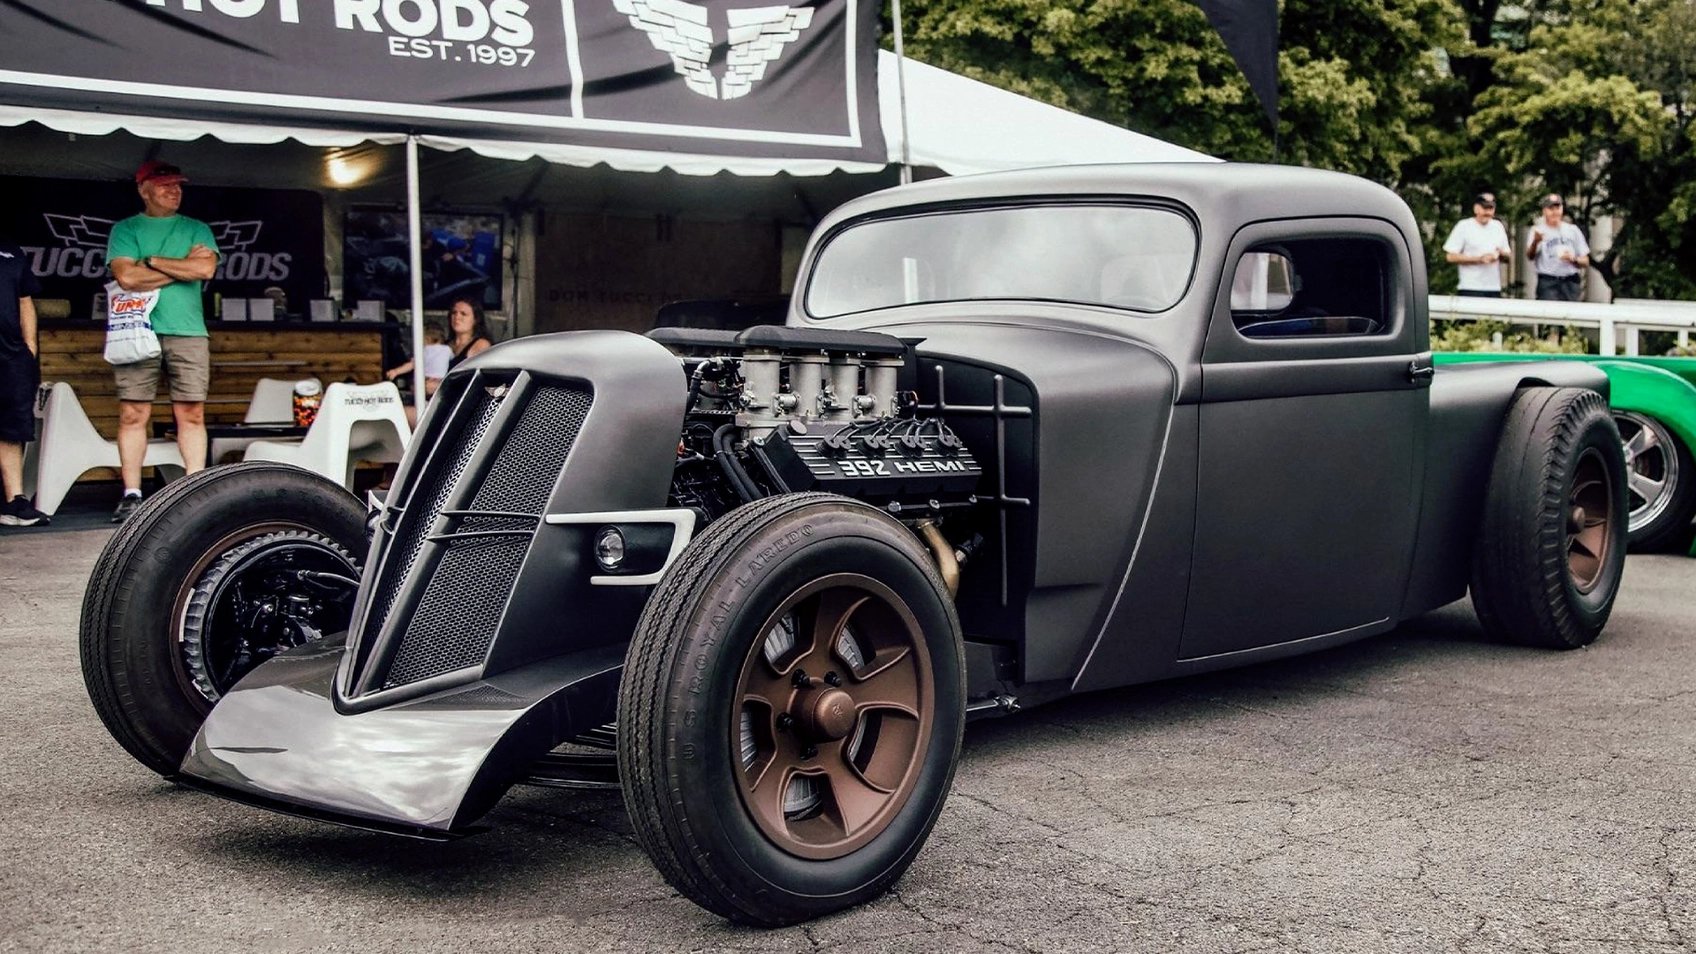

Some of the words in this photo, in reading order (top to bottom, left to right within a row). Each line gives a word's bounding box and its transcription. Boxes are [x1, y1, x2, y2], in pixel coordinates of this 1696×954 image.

[333, 0, 534, 47] RODS
[837, 460, 891, 476] 392
[893, 460, 966, 473] HEMI
[687, 600, 737, 695] ROYAL
[736, 523, 817, 590] LAREDO
